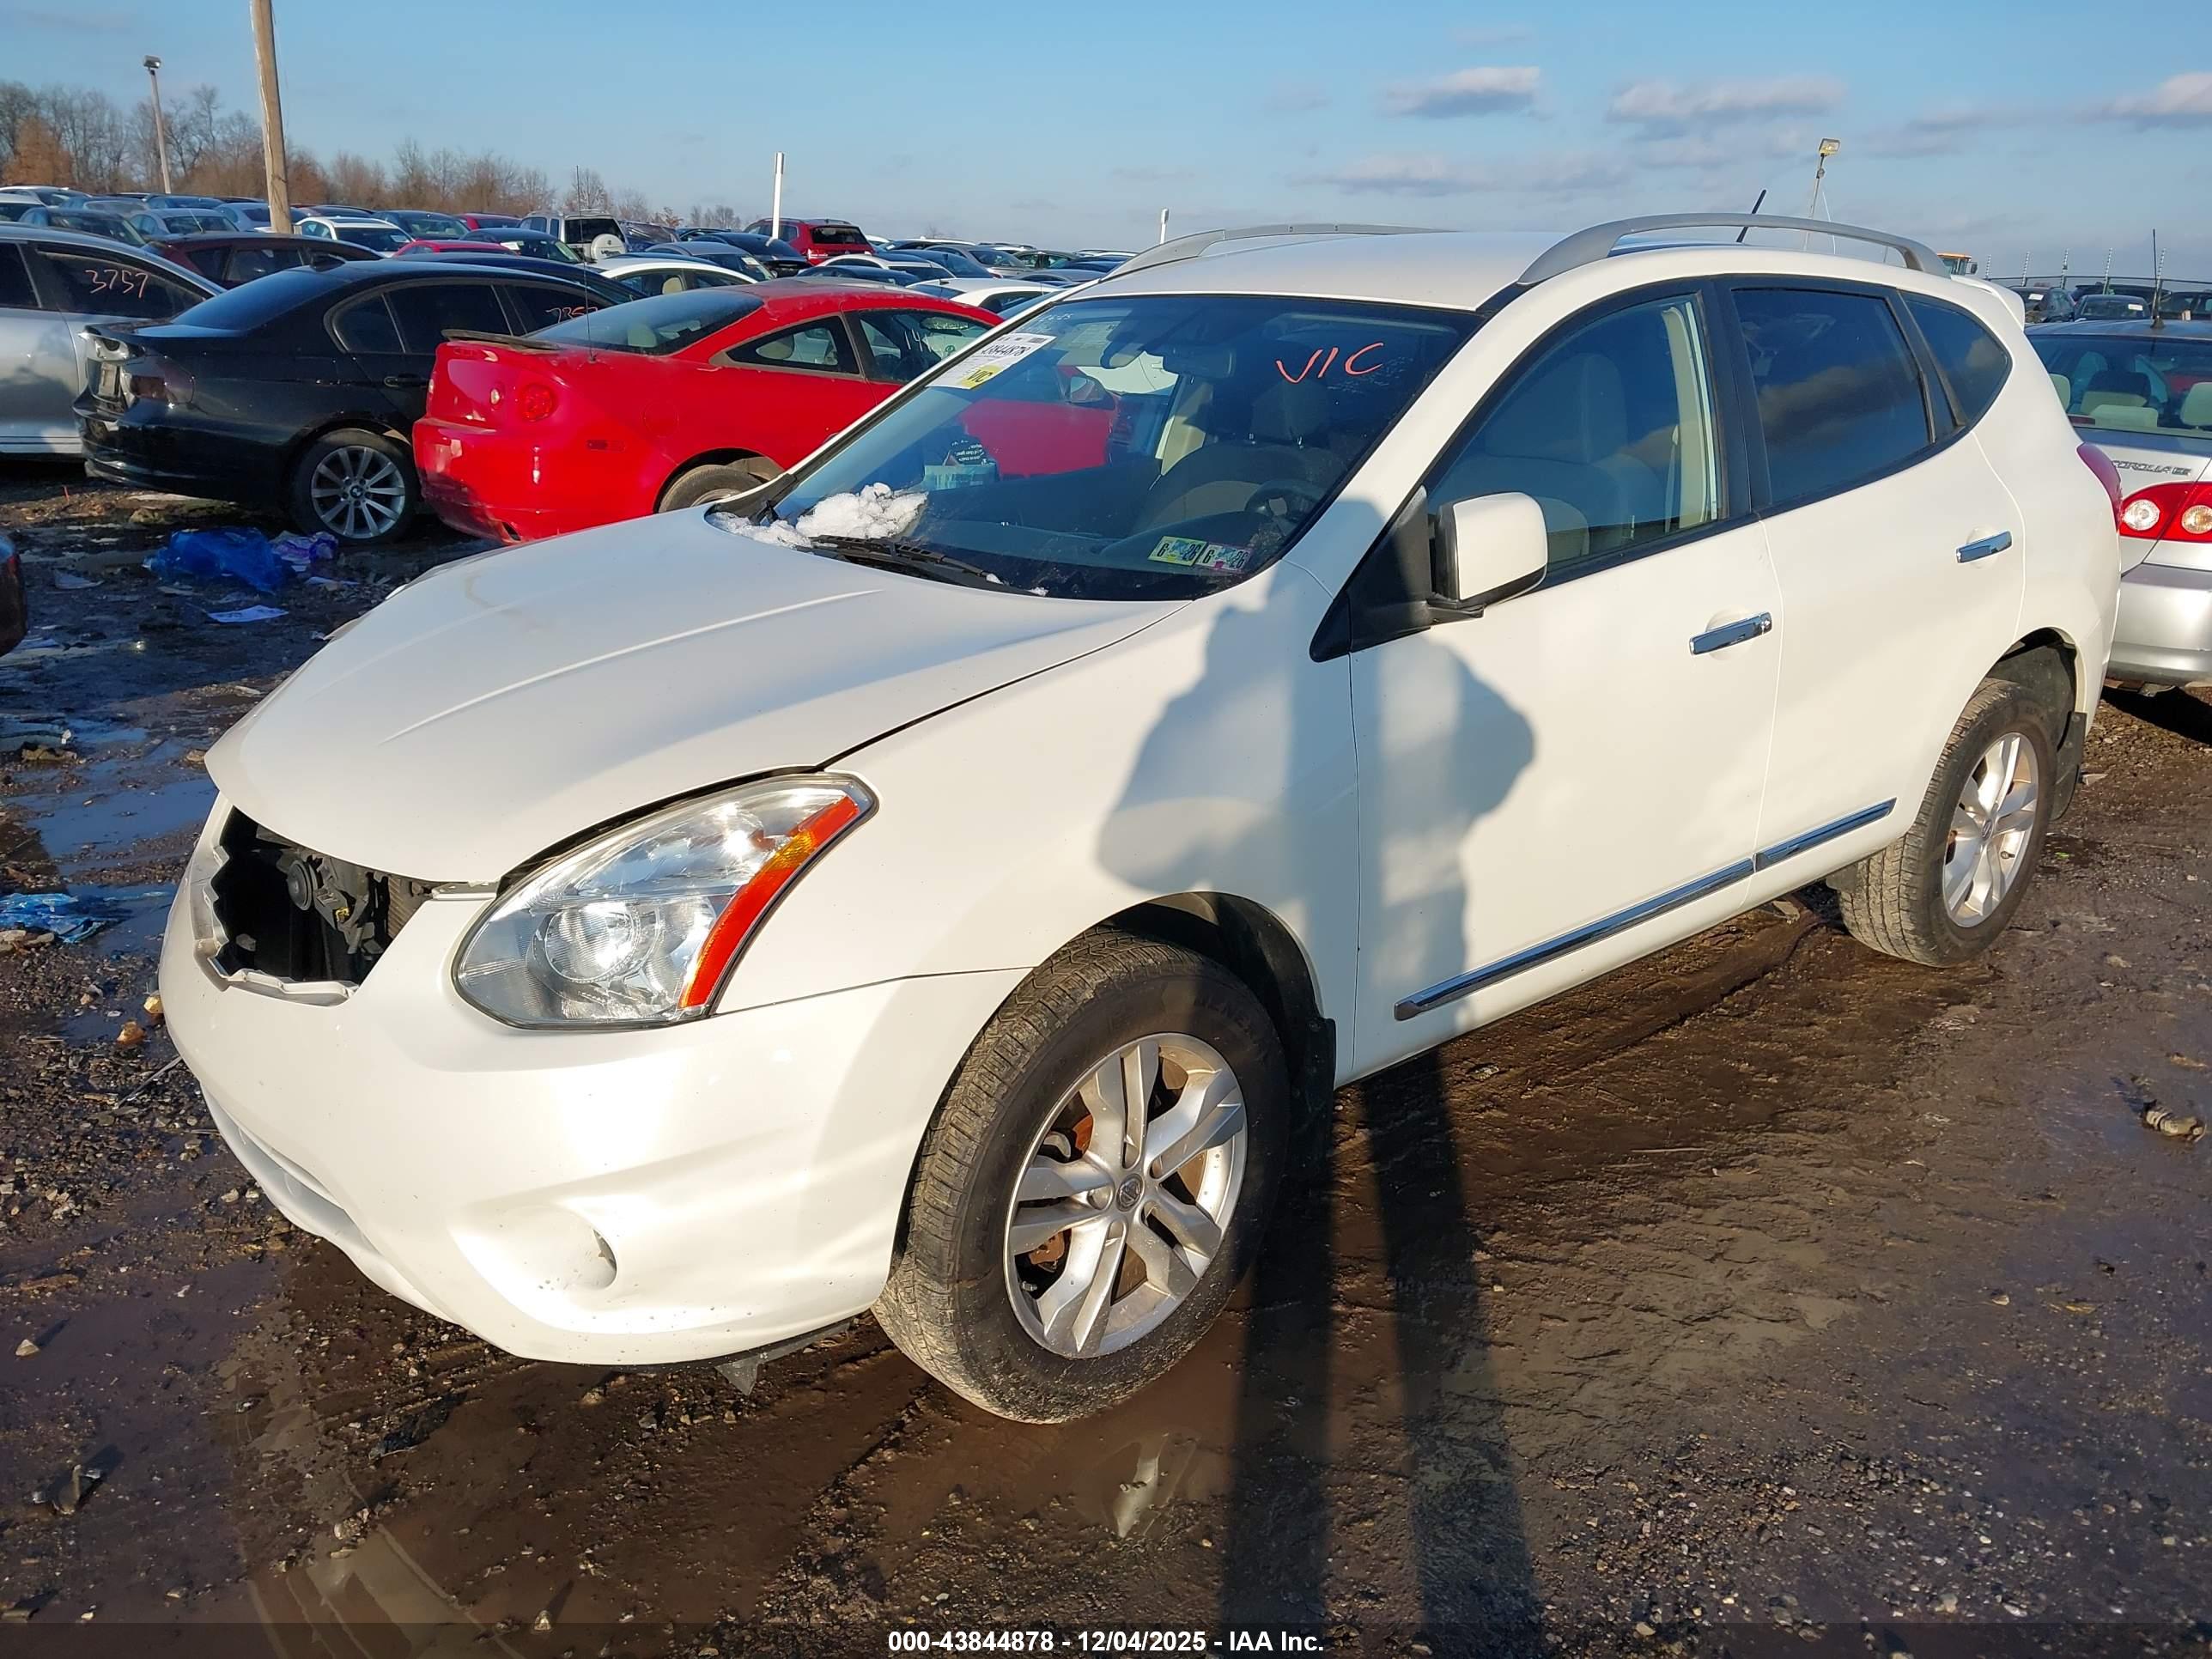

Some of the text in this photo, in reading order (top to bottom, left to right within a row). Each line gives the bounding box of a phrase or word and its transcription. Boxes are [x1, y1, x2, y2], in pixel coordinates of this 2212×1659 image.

[85, 269, 149, 299] 3757
[1275, 342, 1384, 384] VIC
[967, 369, 994, 383] VIC
[1157, 543, 1201, 561] 6 26
[1203, 549, 1215, 564] 6
